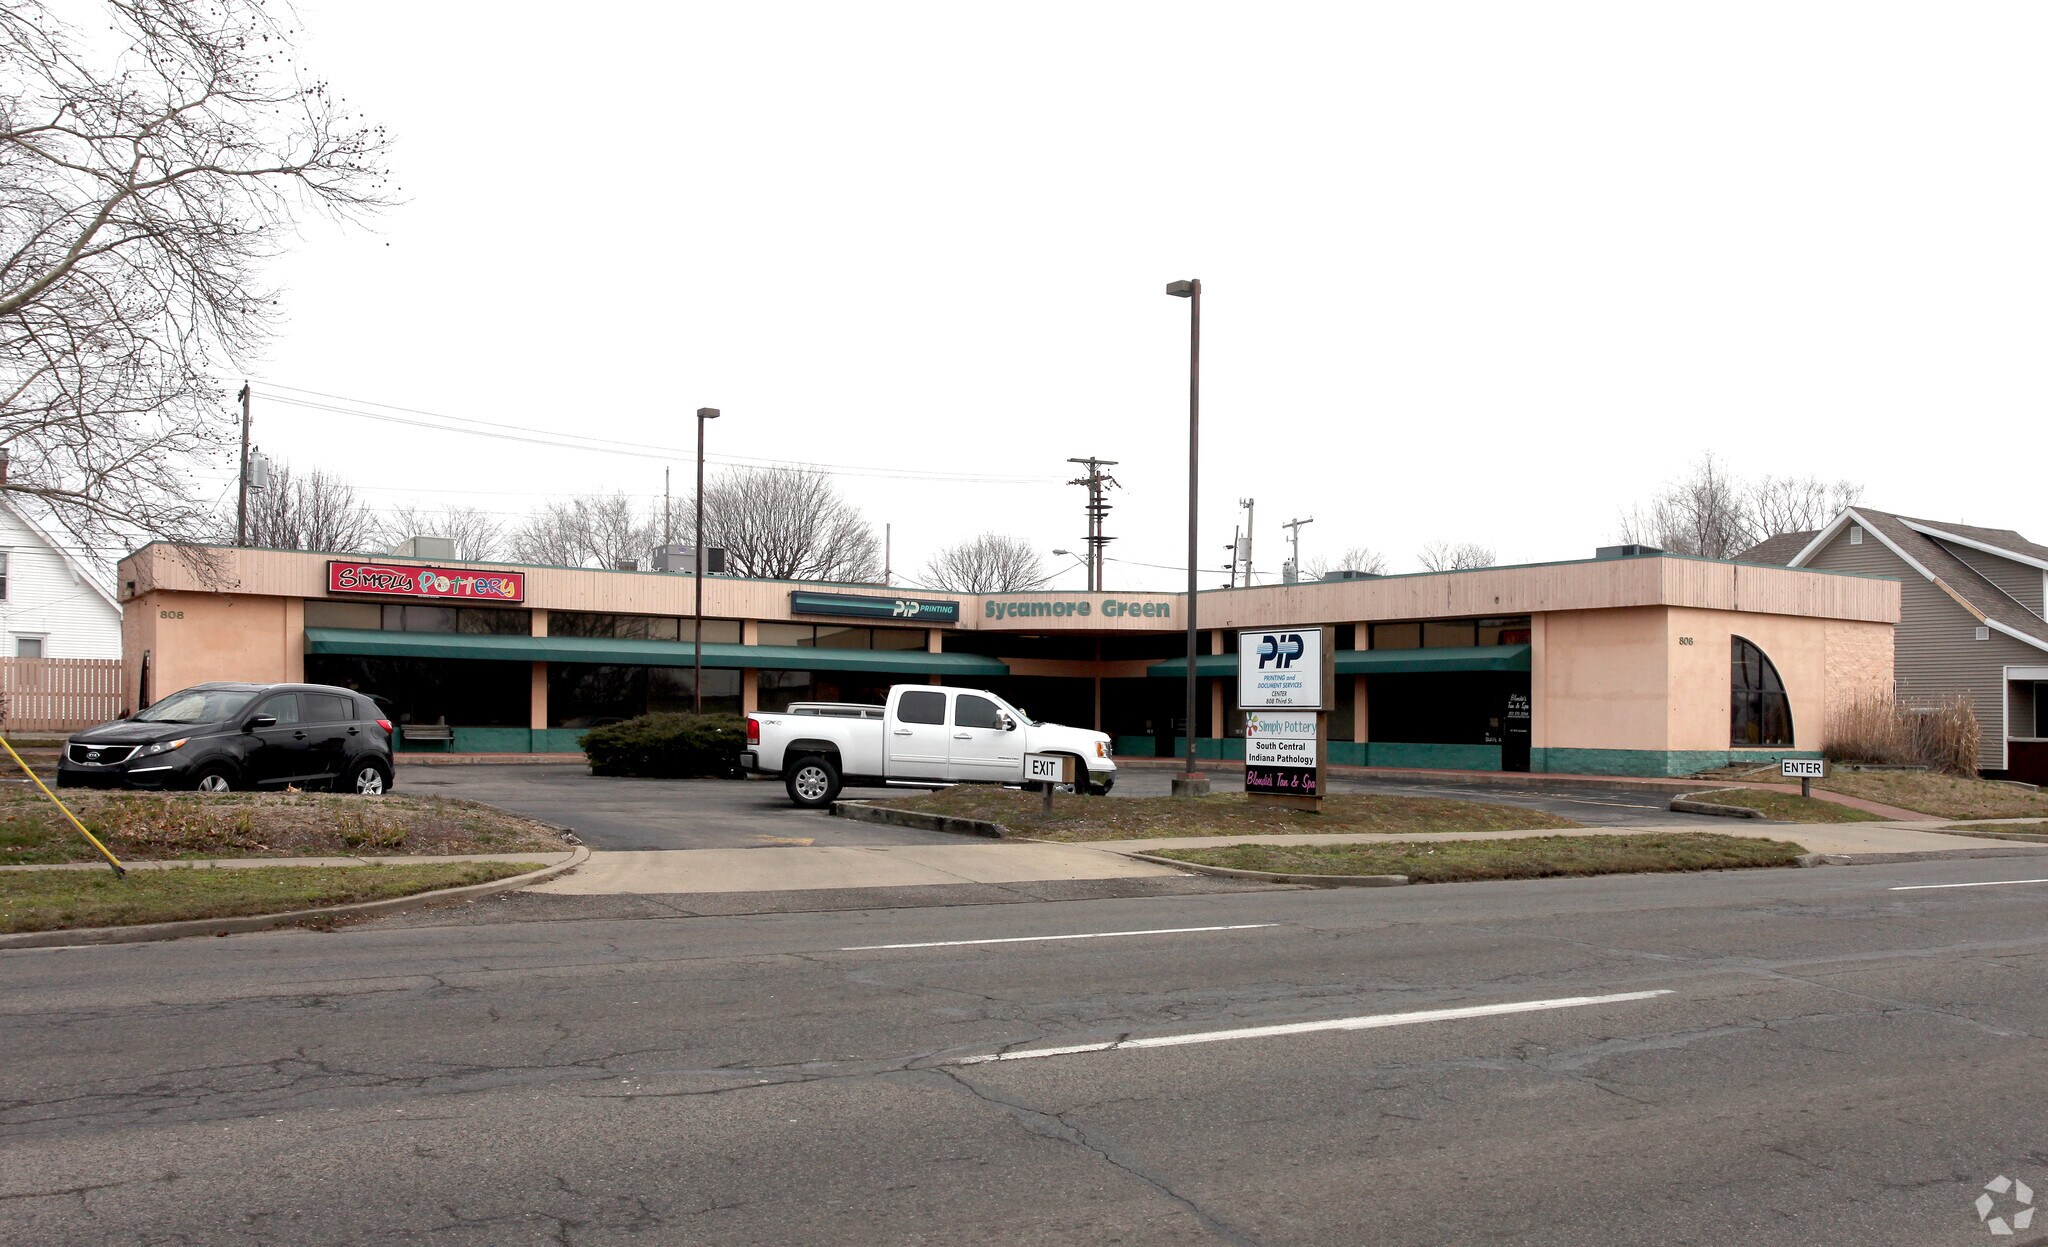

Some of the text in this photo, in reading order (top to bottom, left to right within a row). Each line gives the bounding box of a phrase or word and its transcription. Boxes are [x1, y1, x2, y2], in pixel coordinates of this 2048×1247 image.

[160, 611, 184, 619] 808
[920, 605, 953, 614] PRINTING
[985, 599, 1170, 620] Sycamore Green
[1258, 720, 1317, 735] Simply Pottery
[1256, 742, 1306, 750] South Central
[1249, 753, 1314, 765] Indiana Pathology
[1032, 760, 1055, 776] EXIT
[1784, 762, 1821, 773] ENTER
[1277, 772, 1289, 787] Tan
[1291, 774, 1299, 787] &
[1302, 773, 1316, 793] Spa
